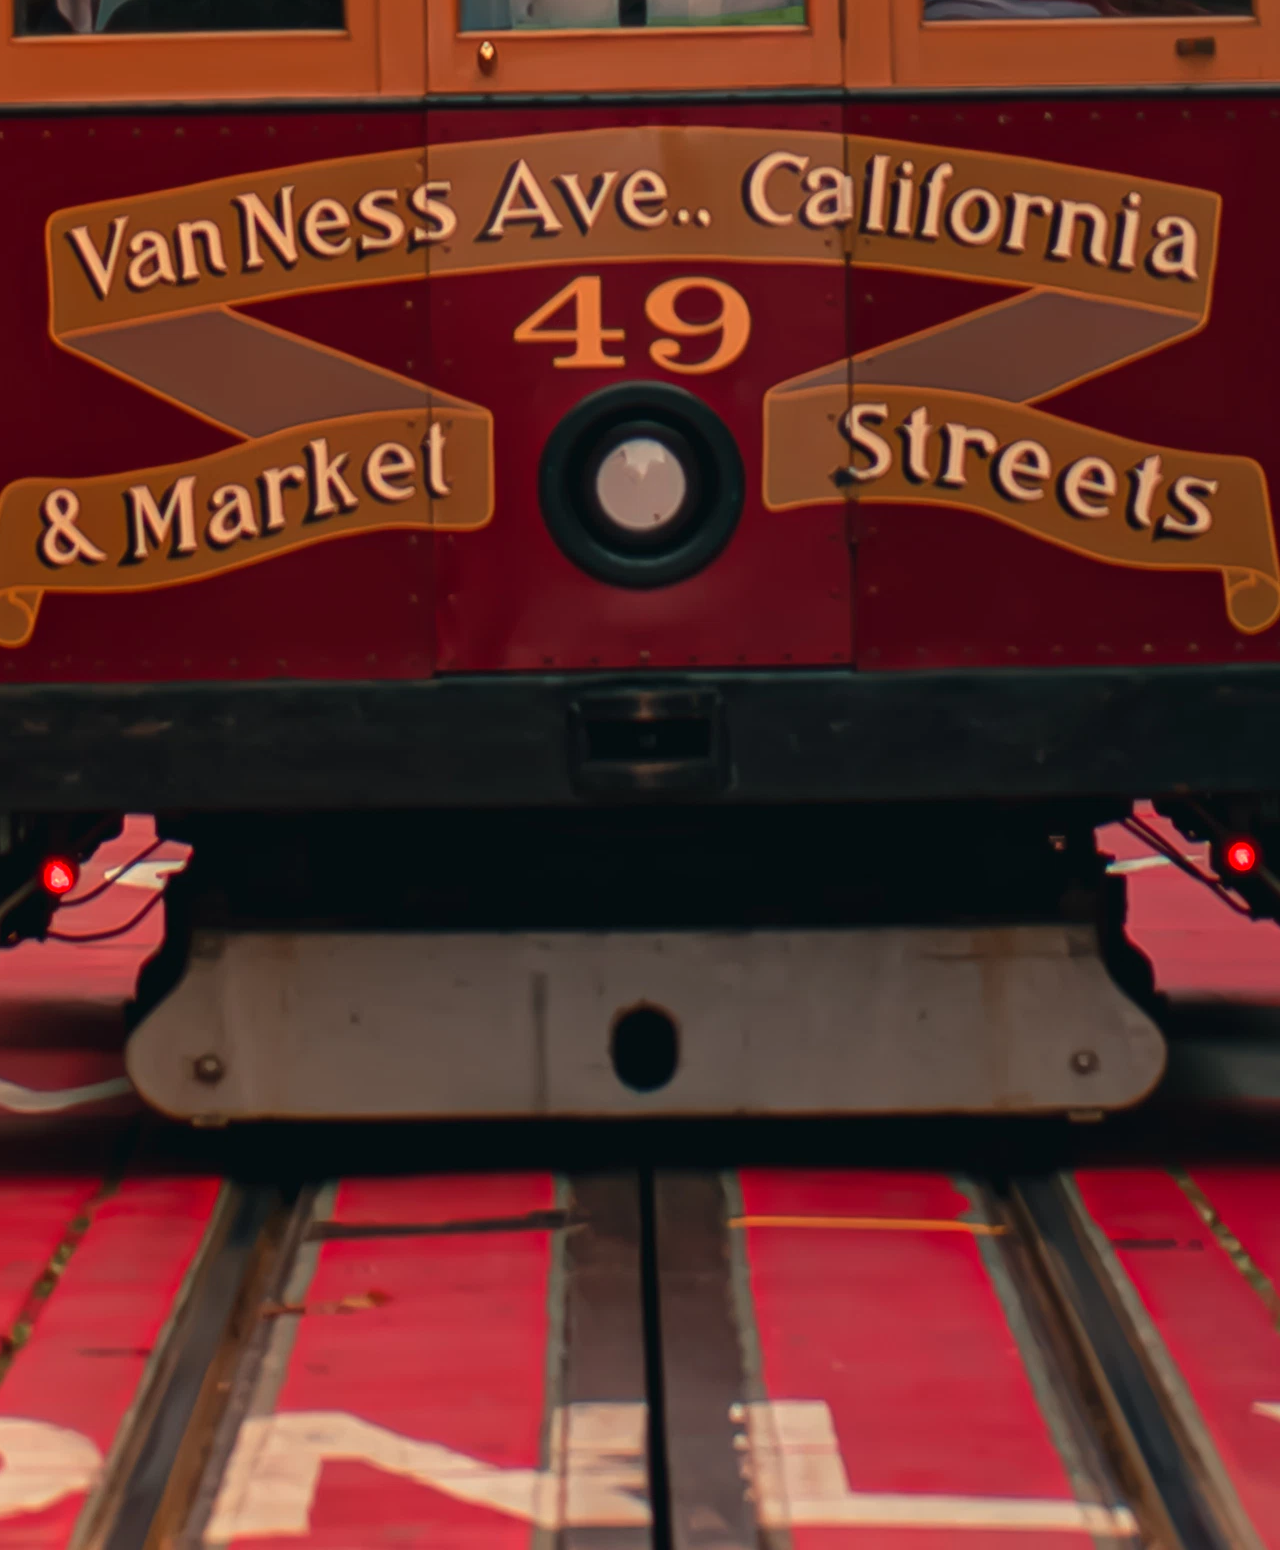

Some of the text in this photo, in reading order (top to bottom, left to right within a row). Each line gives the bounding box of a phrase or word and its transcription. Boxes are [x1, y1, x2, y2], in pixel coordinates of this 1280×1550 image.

[231, 180, 458, 268] Ness
[744, 151, 1200, 281] California
[513, 275, 752, 375] 49
[39, 421, 453, 569] & Market
[837, 402, 1219, 539] Streets
